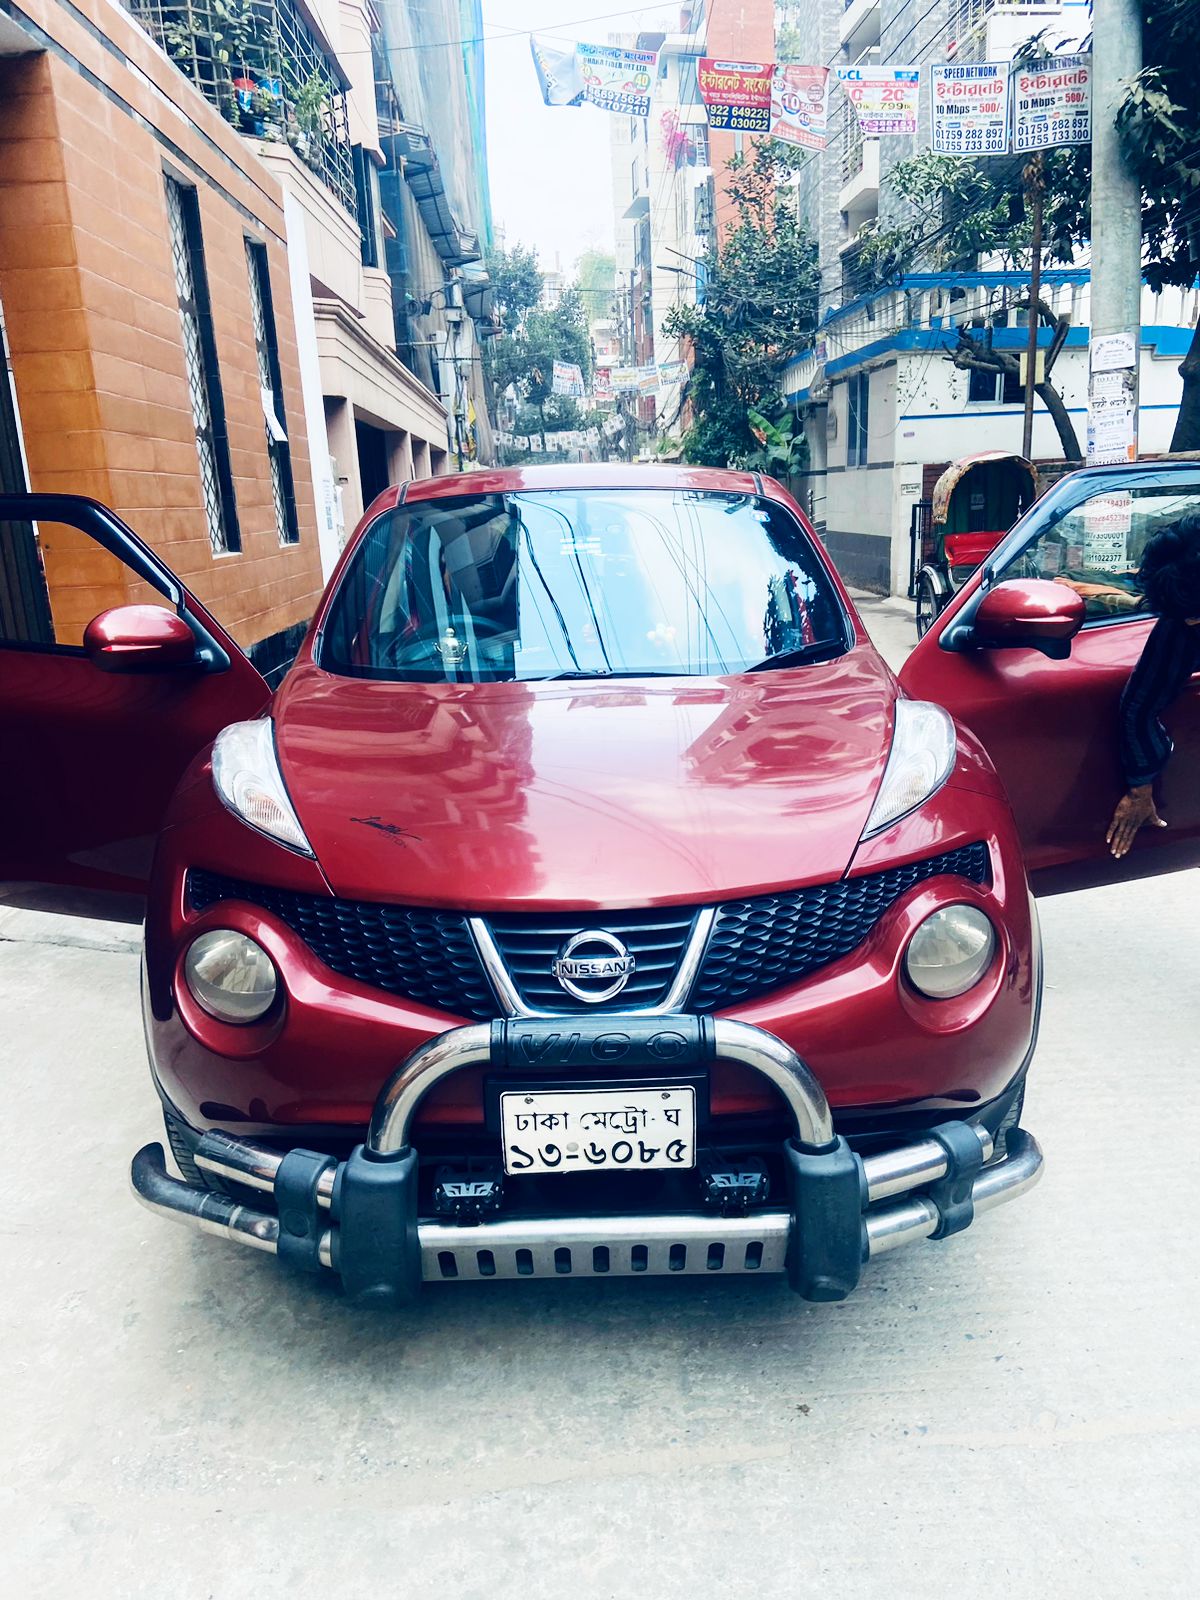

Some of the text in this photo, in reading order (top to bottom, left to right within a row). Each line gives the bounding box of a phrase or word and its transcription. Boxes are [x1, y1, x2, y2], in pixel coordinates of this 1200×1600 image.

[943, 67, 965, 79] SPEED
[965, 66, 998, 79] NETWORK
[1026, 60, 1048, 73] SPEED
[700, 69, 741, 91] ইন্টারনেট
[837, 69, 863, 80] UCL
[1020, 69, 1088, 93] ইন্টারনেট
[936, 79, 1004, 99] ইন্টারনেট
[782, 94, 800, 108] 10
[1019, 100, 1029, 110] 10
[1031, 97, 1055, 109] Mbps
[1065, 92, 1088, 103] 500/-
[731, 105, 770, 119] 649226
[935, 104, 945, 115] 10
[946, 104, 970, 115] Mbps
[979, 102, 1004, 113] 500/-
[730, 117, 769, 130] 030022
[1017, 122, 1049, 136] 01759
[1051, 119, 1070, 131] 282
[1071, 118, 1089, 128] 897
[935, 128, 1003, 140] 01759 282 897
[1017, 129, 1089, 147] 01755 733 300
[935, 139, 1003, 151] 01755 733 300
[560, 961, 627, 975] NISSAN
[519, 1030, 689, 1064] VIGO
[514, 1111, 570, 1132] ঢাকা
[663, 1108, 682, 1127] ঘ
[510, 1138, 688, 1169] ১৩-৬০৮৫
